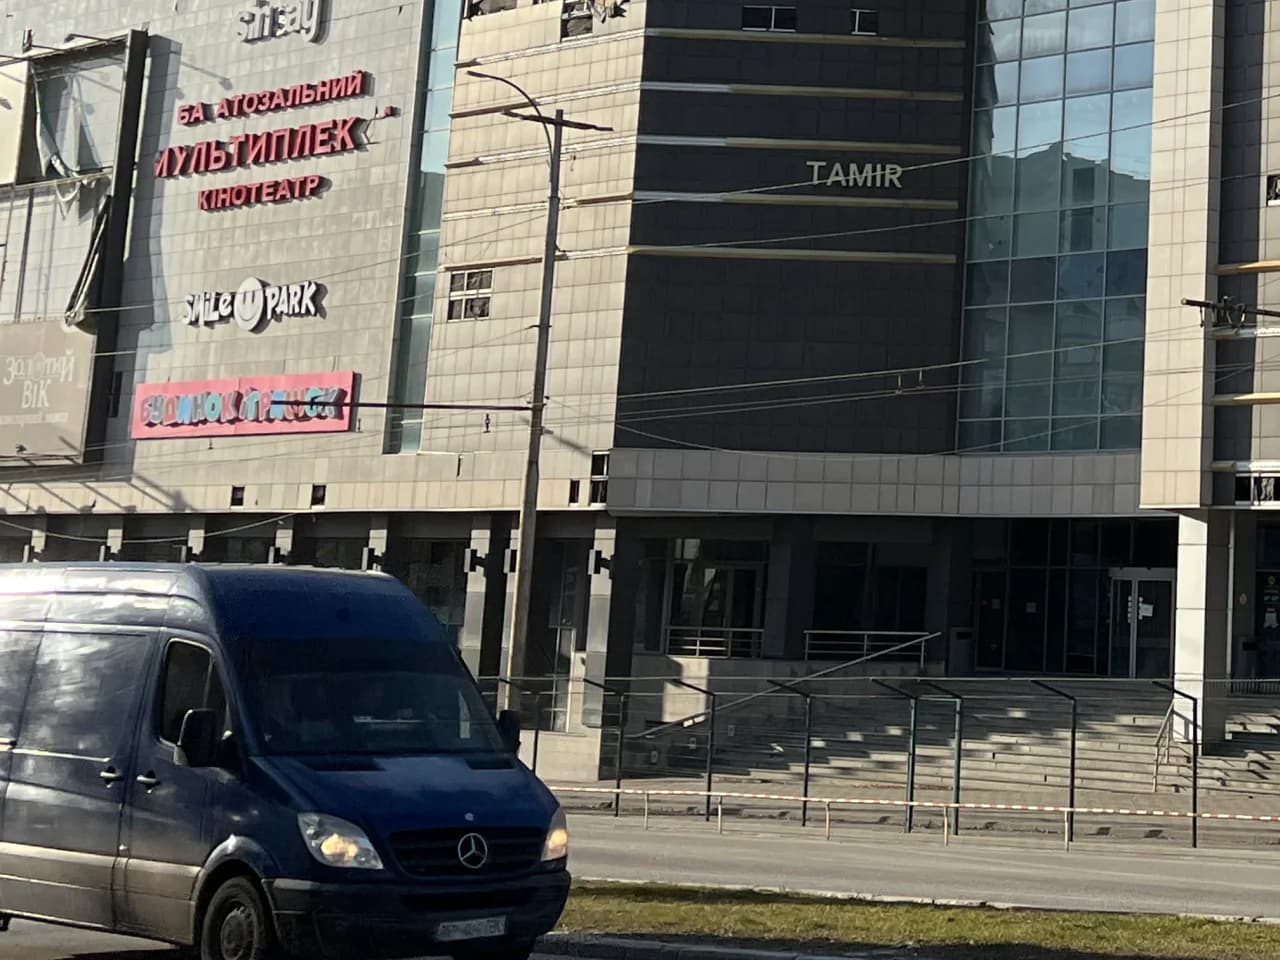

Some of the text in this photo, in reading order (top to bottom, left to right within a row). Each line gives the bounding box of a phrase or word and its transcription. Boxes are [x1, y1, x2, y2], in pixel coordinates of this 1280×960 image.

[806, 161, 902, 188] TAMIR
[198, 175, 320, 211] КІНОТЕАТР
[265, 280, 317, 320] PARK
[141, 391, 238, 425] БУДИНОК
